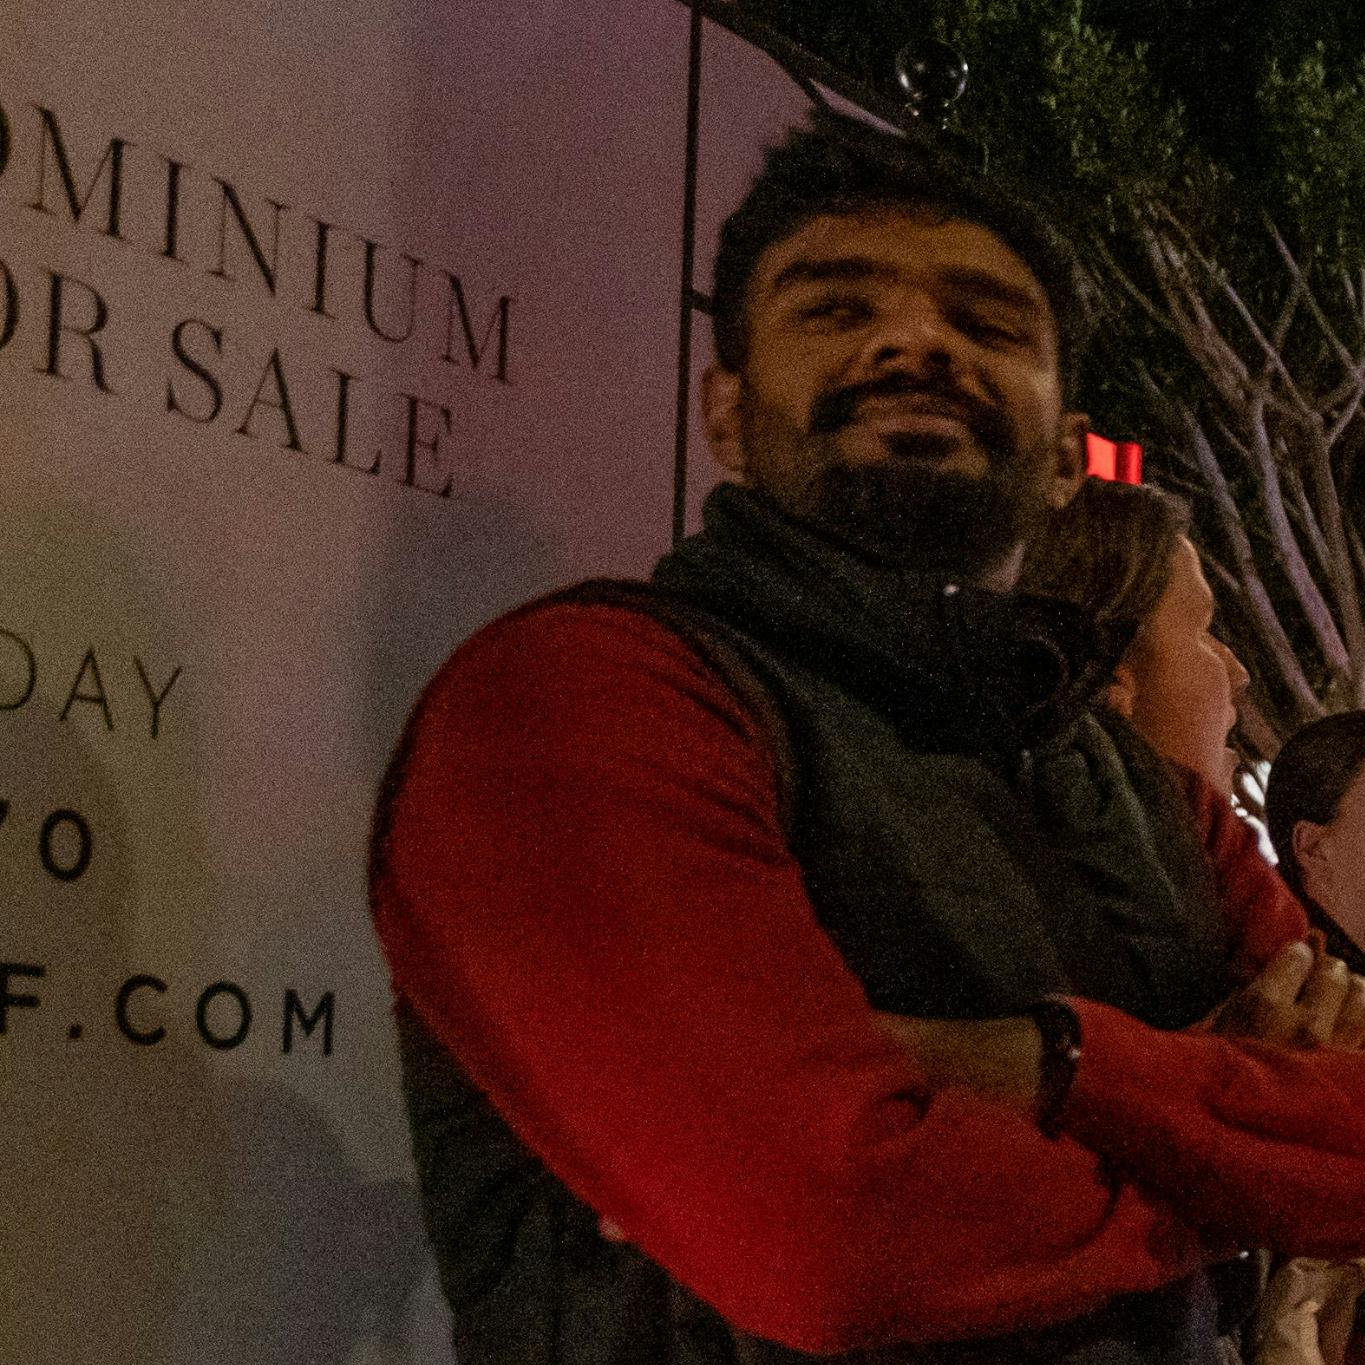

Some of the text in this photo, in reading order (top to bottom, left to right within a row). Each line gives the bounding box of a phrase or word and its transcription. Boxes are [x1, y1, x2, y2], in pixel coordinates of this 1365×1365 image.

[0, 103, 514, 387] MINIUM
[0, 258, 455, 499] R SALE
